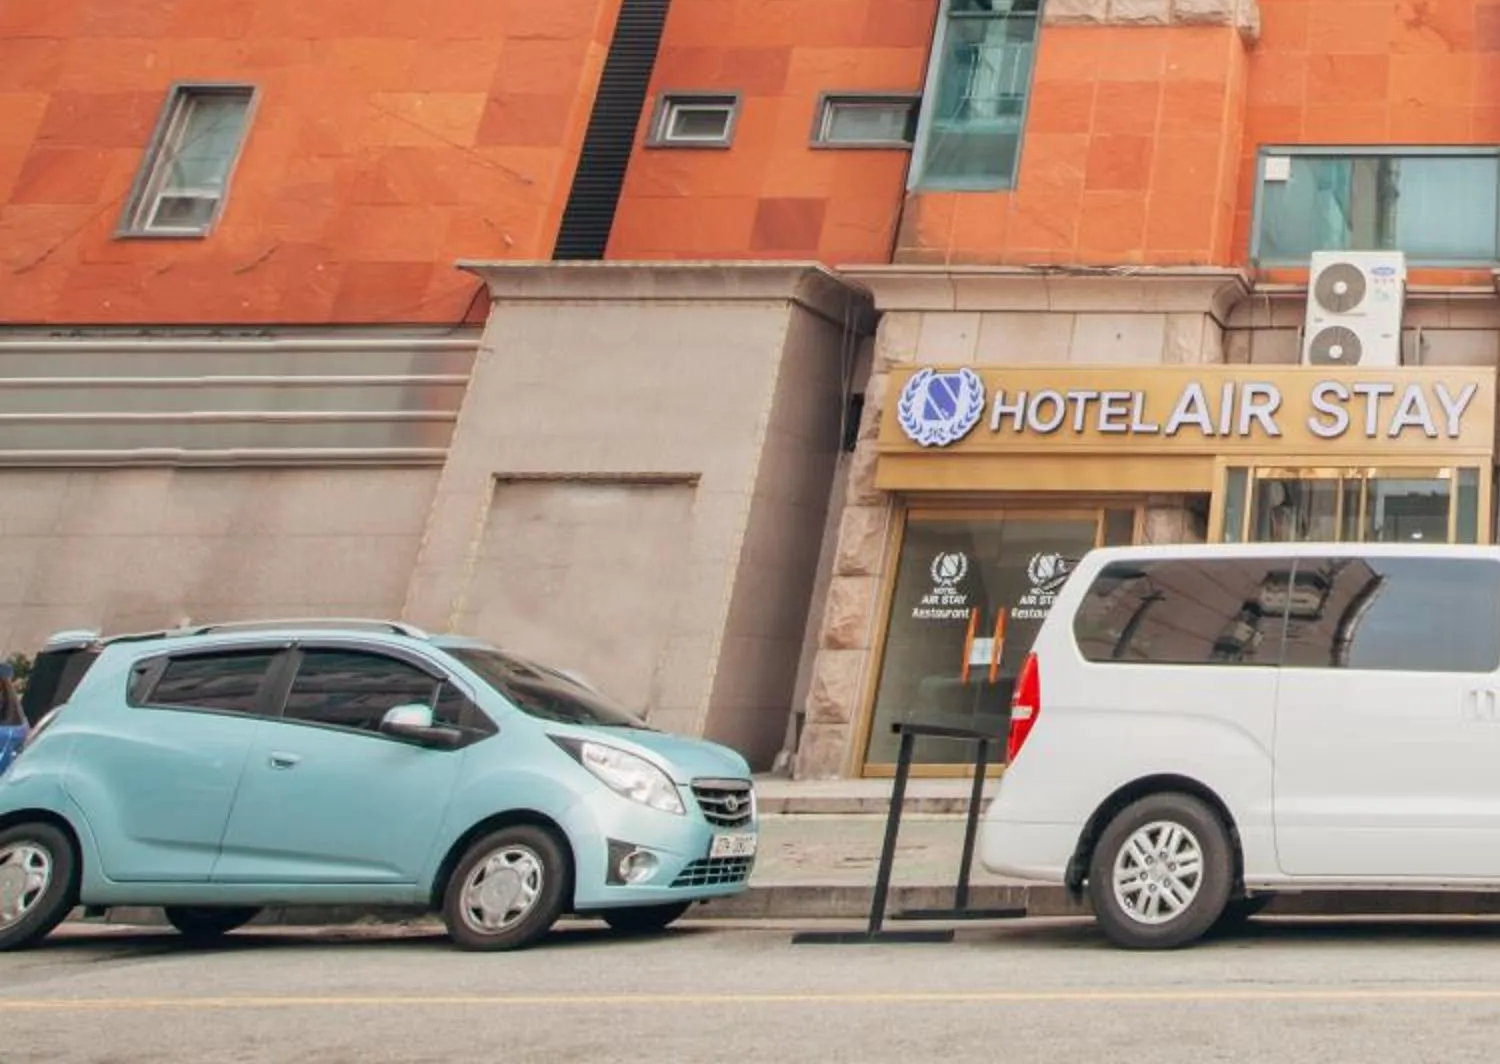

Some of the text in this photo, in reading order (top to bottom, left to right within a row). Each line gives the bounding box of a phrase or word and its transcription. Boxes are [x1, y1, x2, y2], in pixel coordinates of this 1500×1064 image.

[990, 380, 1479, 439] HOTEL AIR STAY
[921, 595, 967, 605] AIR STAY
[1019, 595, 1037, 605] AIR
